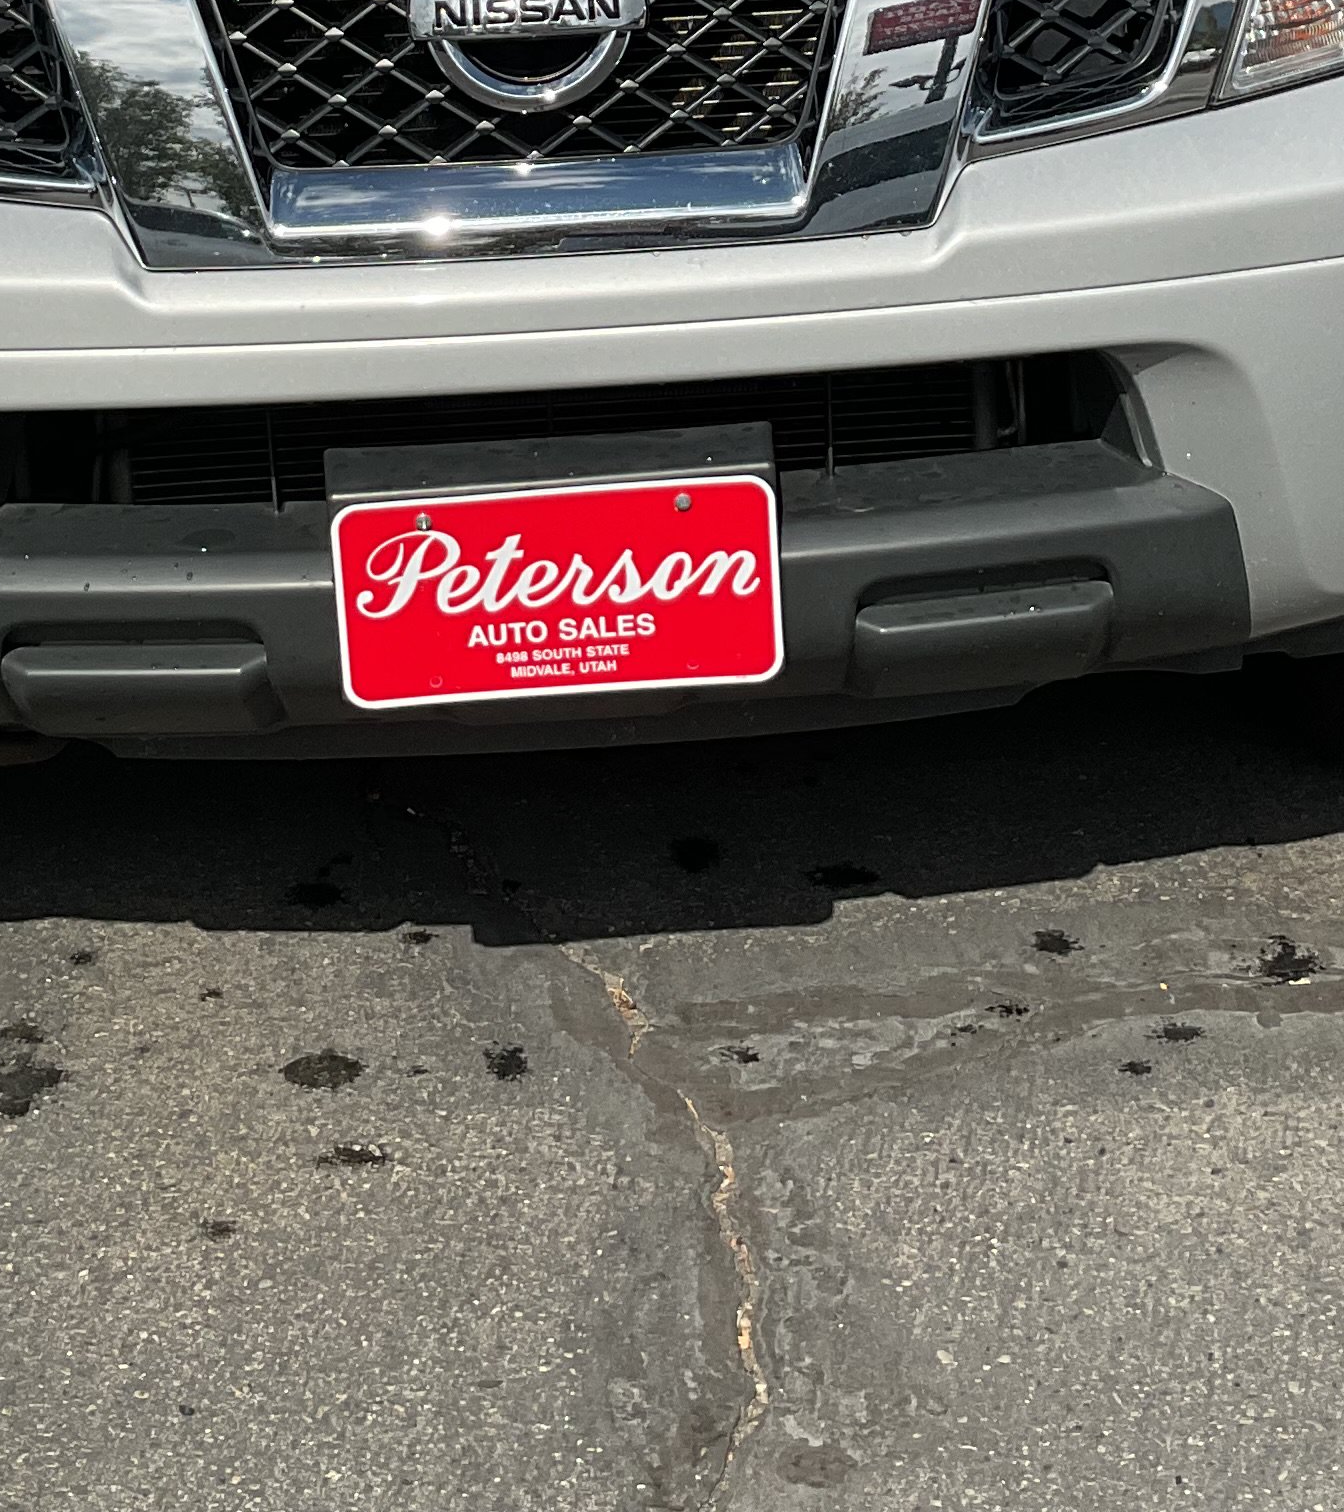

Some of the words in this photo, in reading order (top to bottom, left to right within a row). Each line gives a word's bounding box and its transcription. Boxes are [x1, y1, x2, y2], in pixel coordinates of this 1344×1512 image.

[356, 530, 761, 619] Peterson
[467, 621, 549, 648] AUTO
[558, 613, 657, 641] SALES
[495, 651, 529, 664] 8498
[531, 647, 583, 662] SOUTH
[585, 644, 631, 658] STATE
[510, 662, 576, 678] MIDVALE,
[579, 660, 617, 674] UTAH
